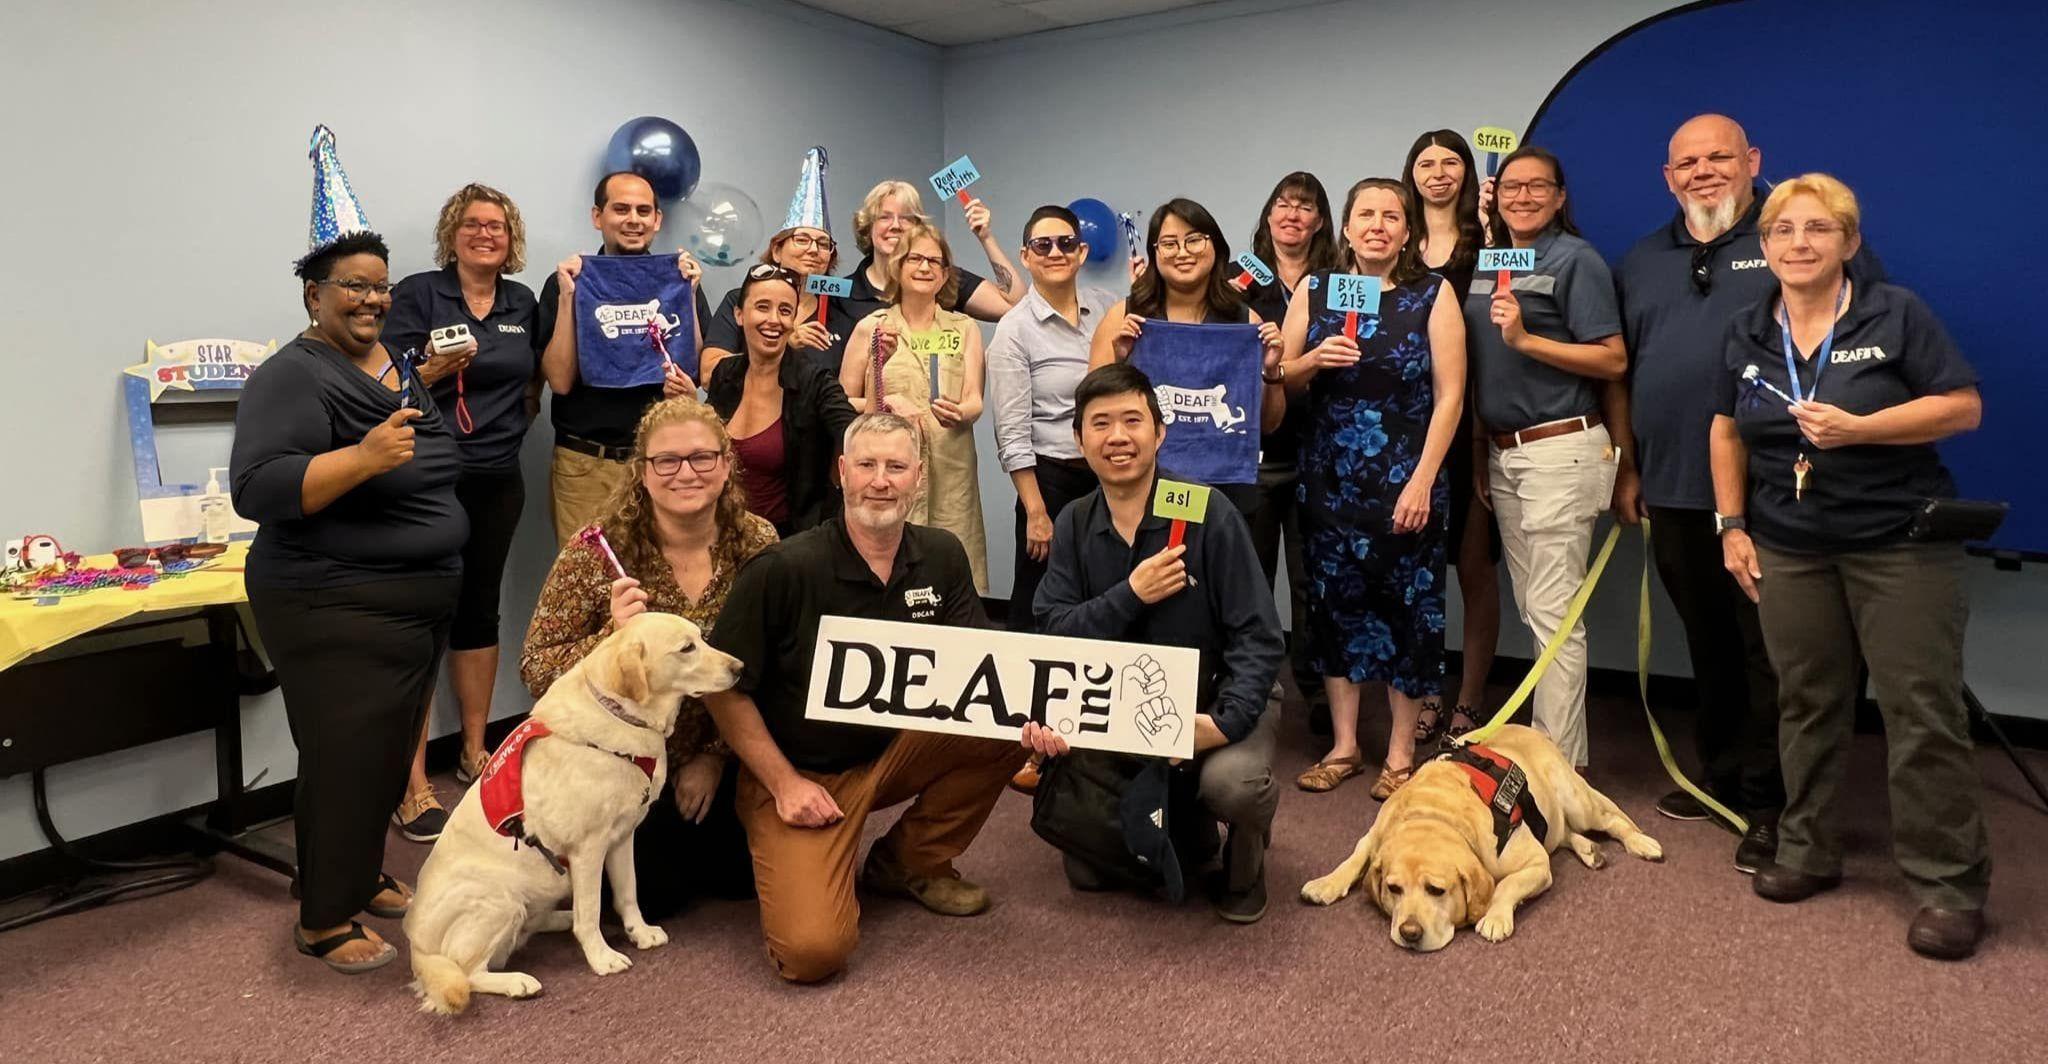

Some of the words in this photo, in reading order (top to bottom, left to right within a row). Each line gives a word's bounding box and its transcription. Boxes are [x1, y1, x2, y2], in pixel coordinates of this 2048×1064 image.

[1477, 133, 1511, 149] STAFF
[934, 168, 957, 189] Deaf
[1485, 251, 1529, 267] DBCAN
[1338, 277, 1364, 294] BYE
[1339, 292, 1367, 308] 215
[614, 310, 647, 321] DEAF
[938, 333, 960, 350] 215
[197, 344, 234, 363] STAR
[1831, 348, 1864, 364] DEAF
[157, 364, 257, 383] STUDEN
[1174, 393, 1212, 407] DEAF
[1165, 490, 1190, 507] asl
